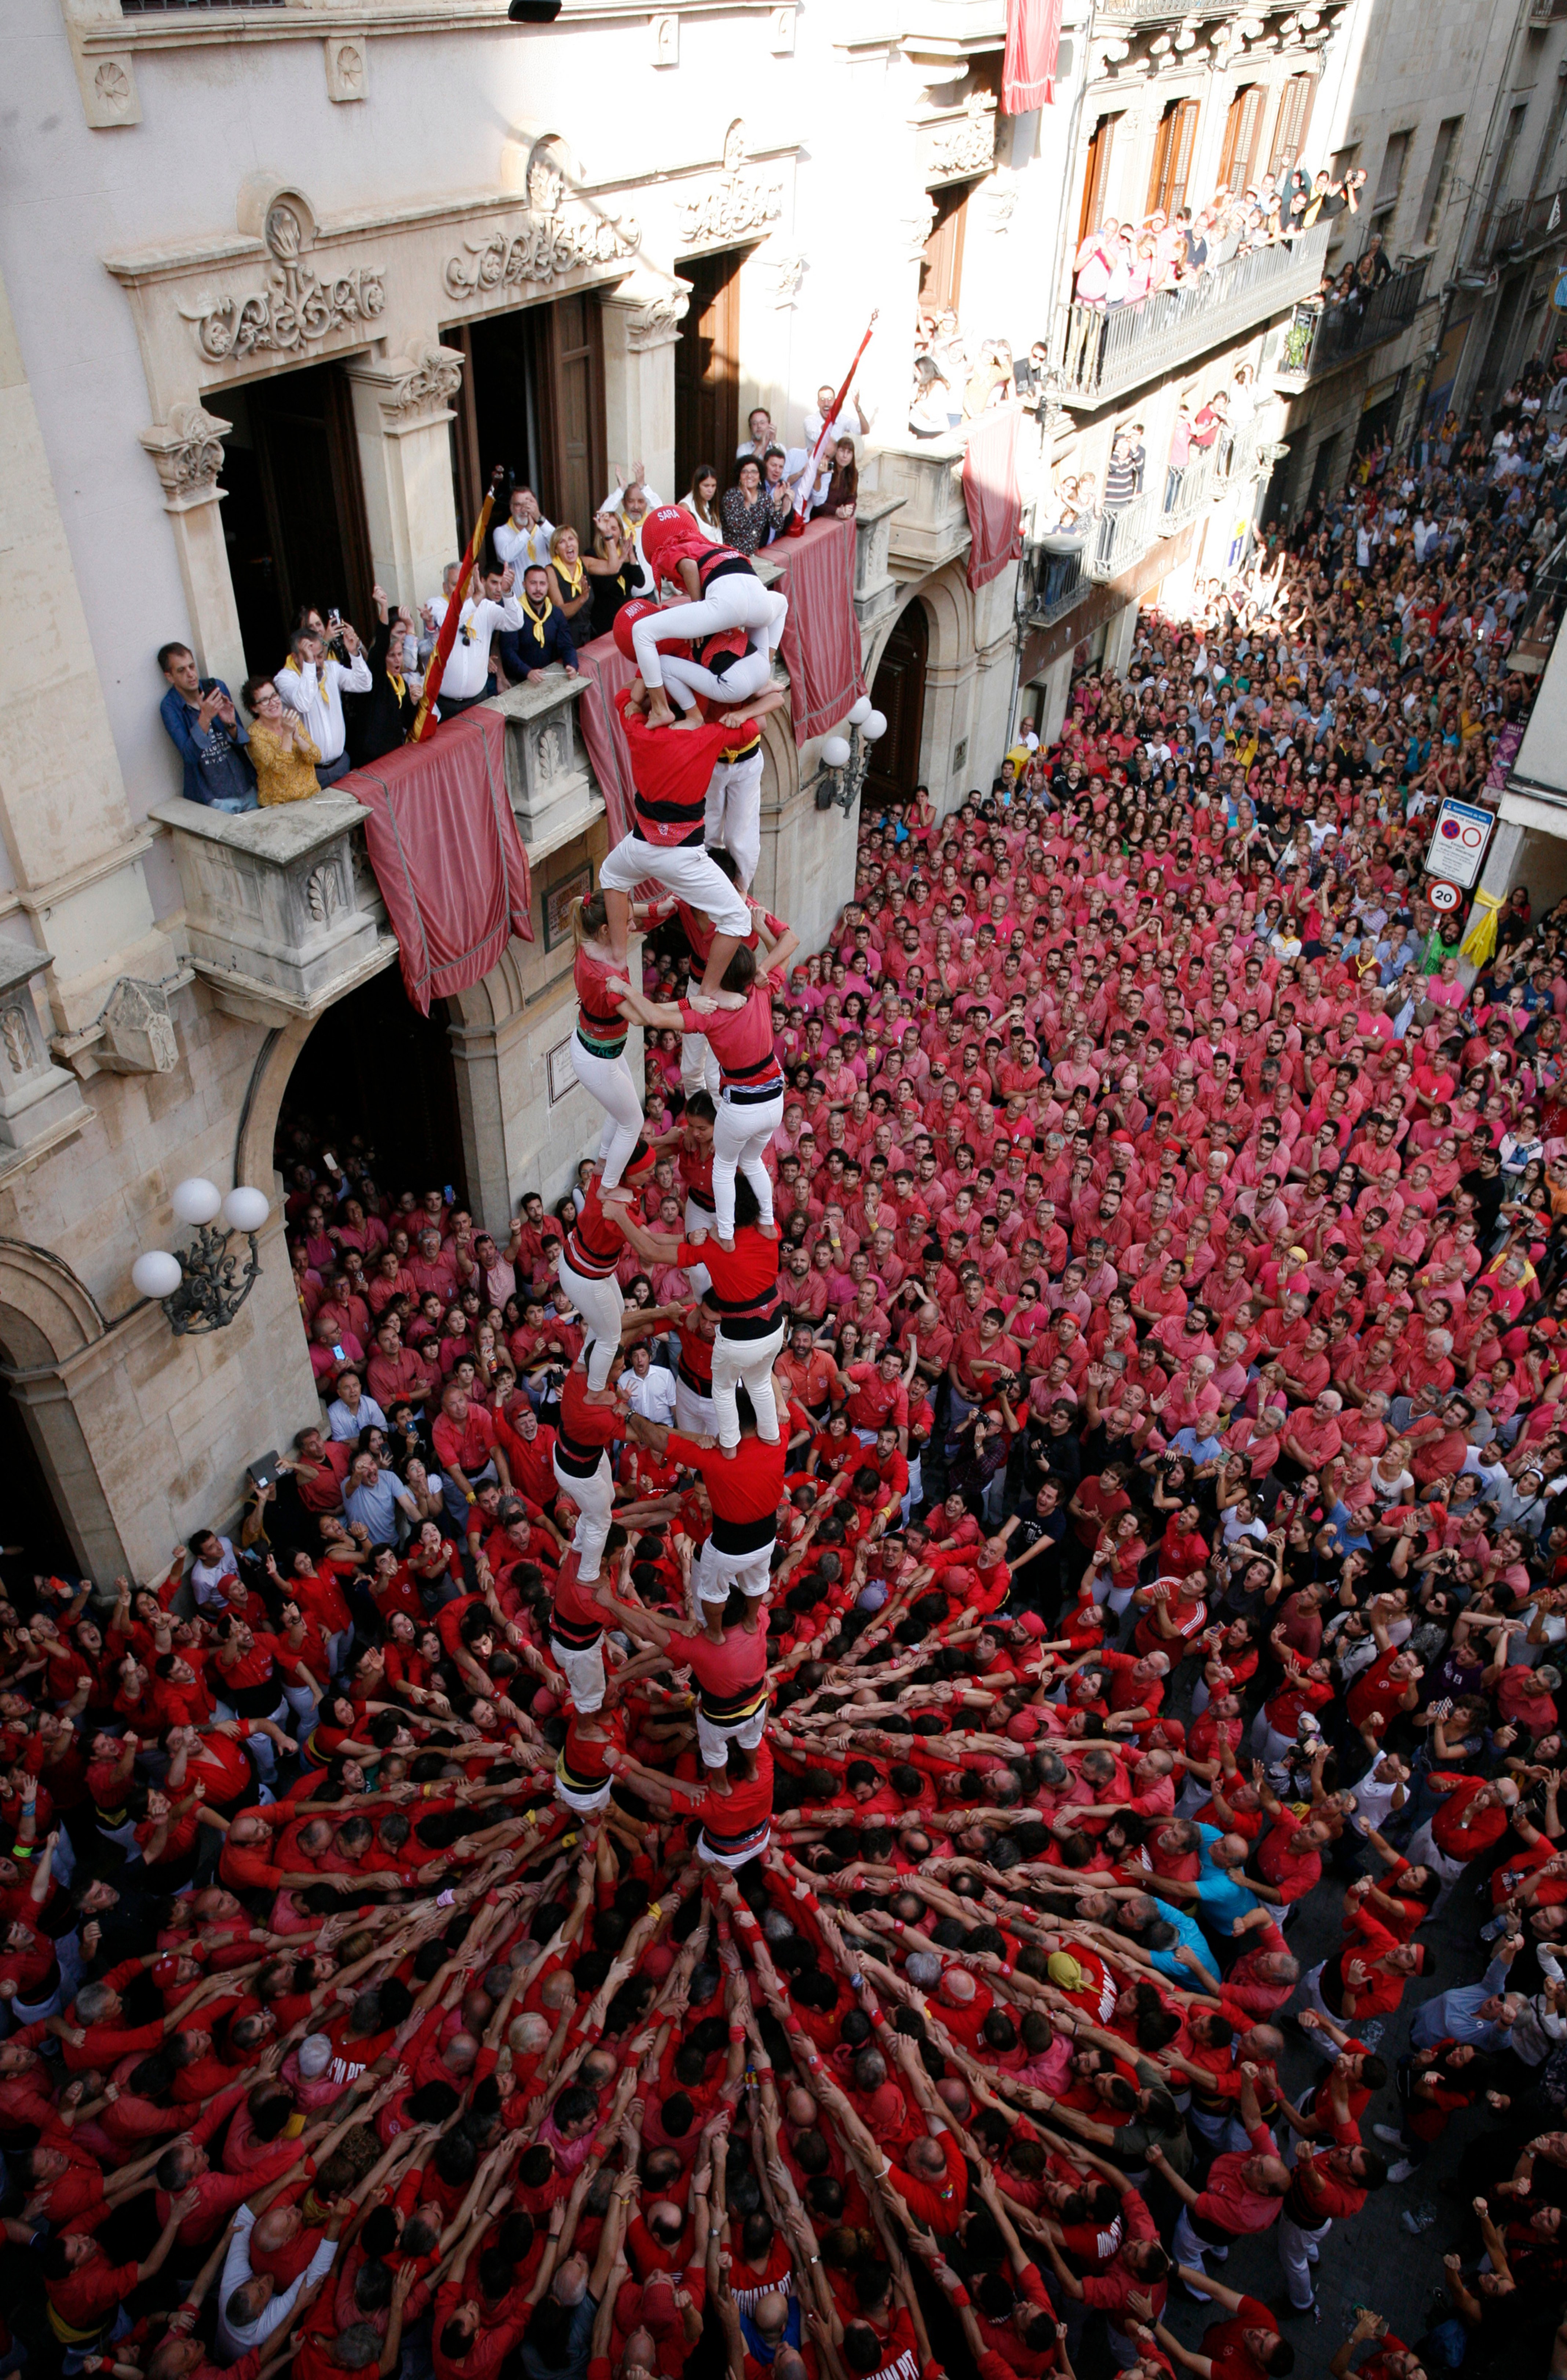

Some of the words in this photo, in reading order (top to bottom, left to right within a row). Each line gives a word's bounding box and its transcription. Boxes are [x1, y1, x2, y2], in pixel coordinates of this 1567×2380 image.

[657, 509, 680, 521] SARA
[625, 602, 646, 619] AMAYA
[1507, 724, 1524, 733] VALLS
[1465, 819, 1486, 829] VIANANTS
[1435, 890, 1452, 903] 20
